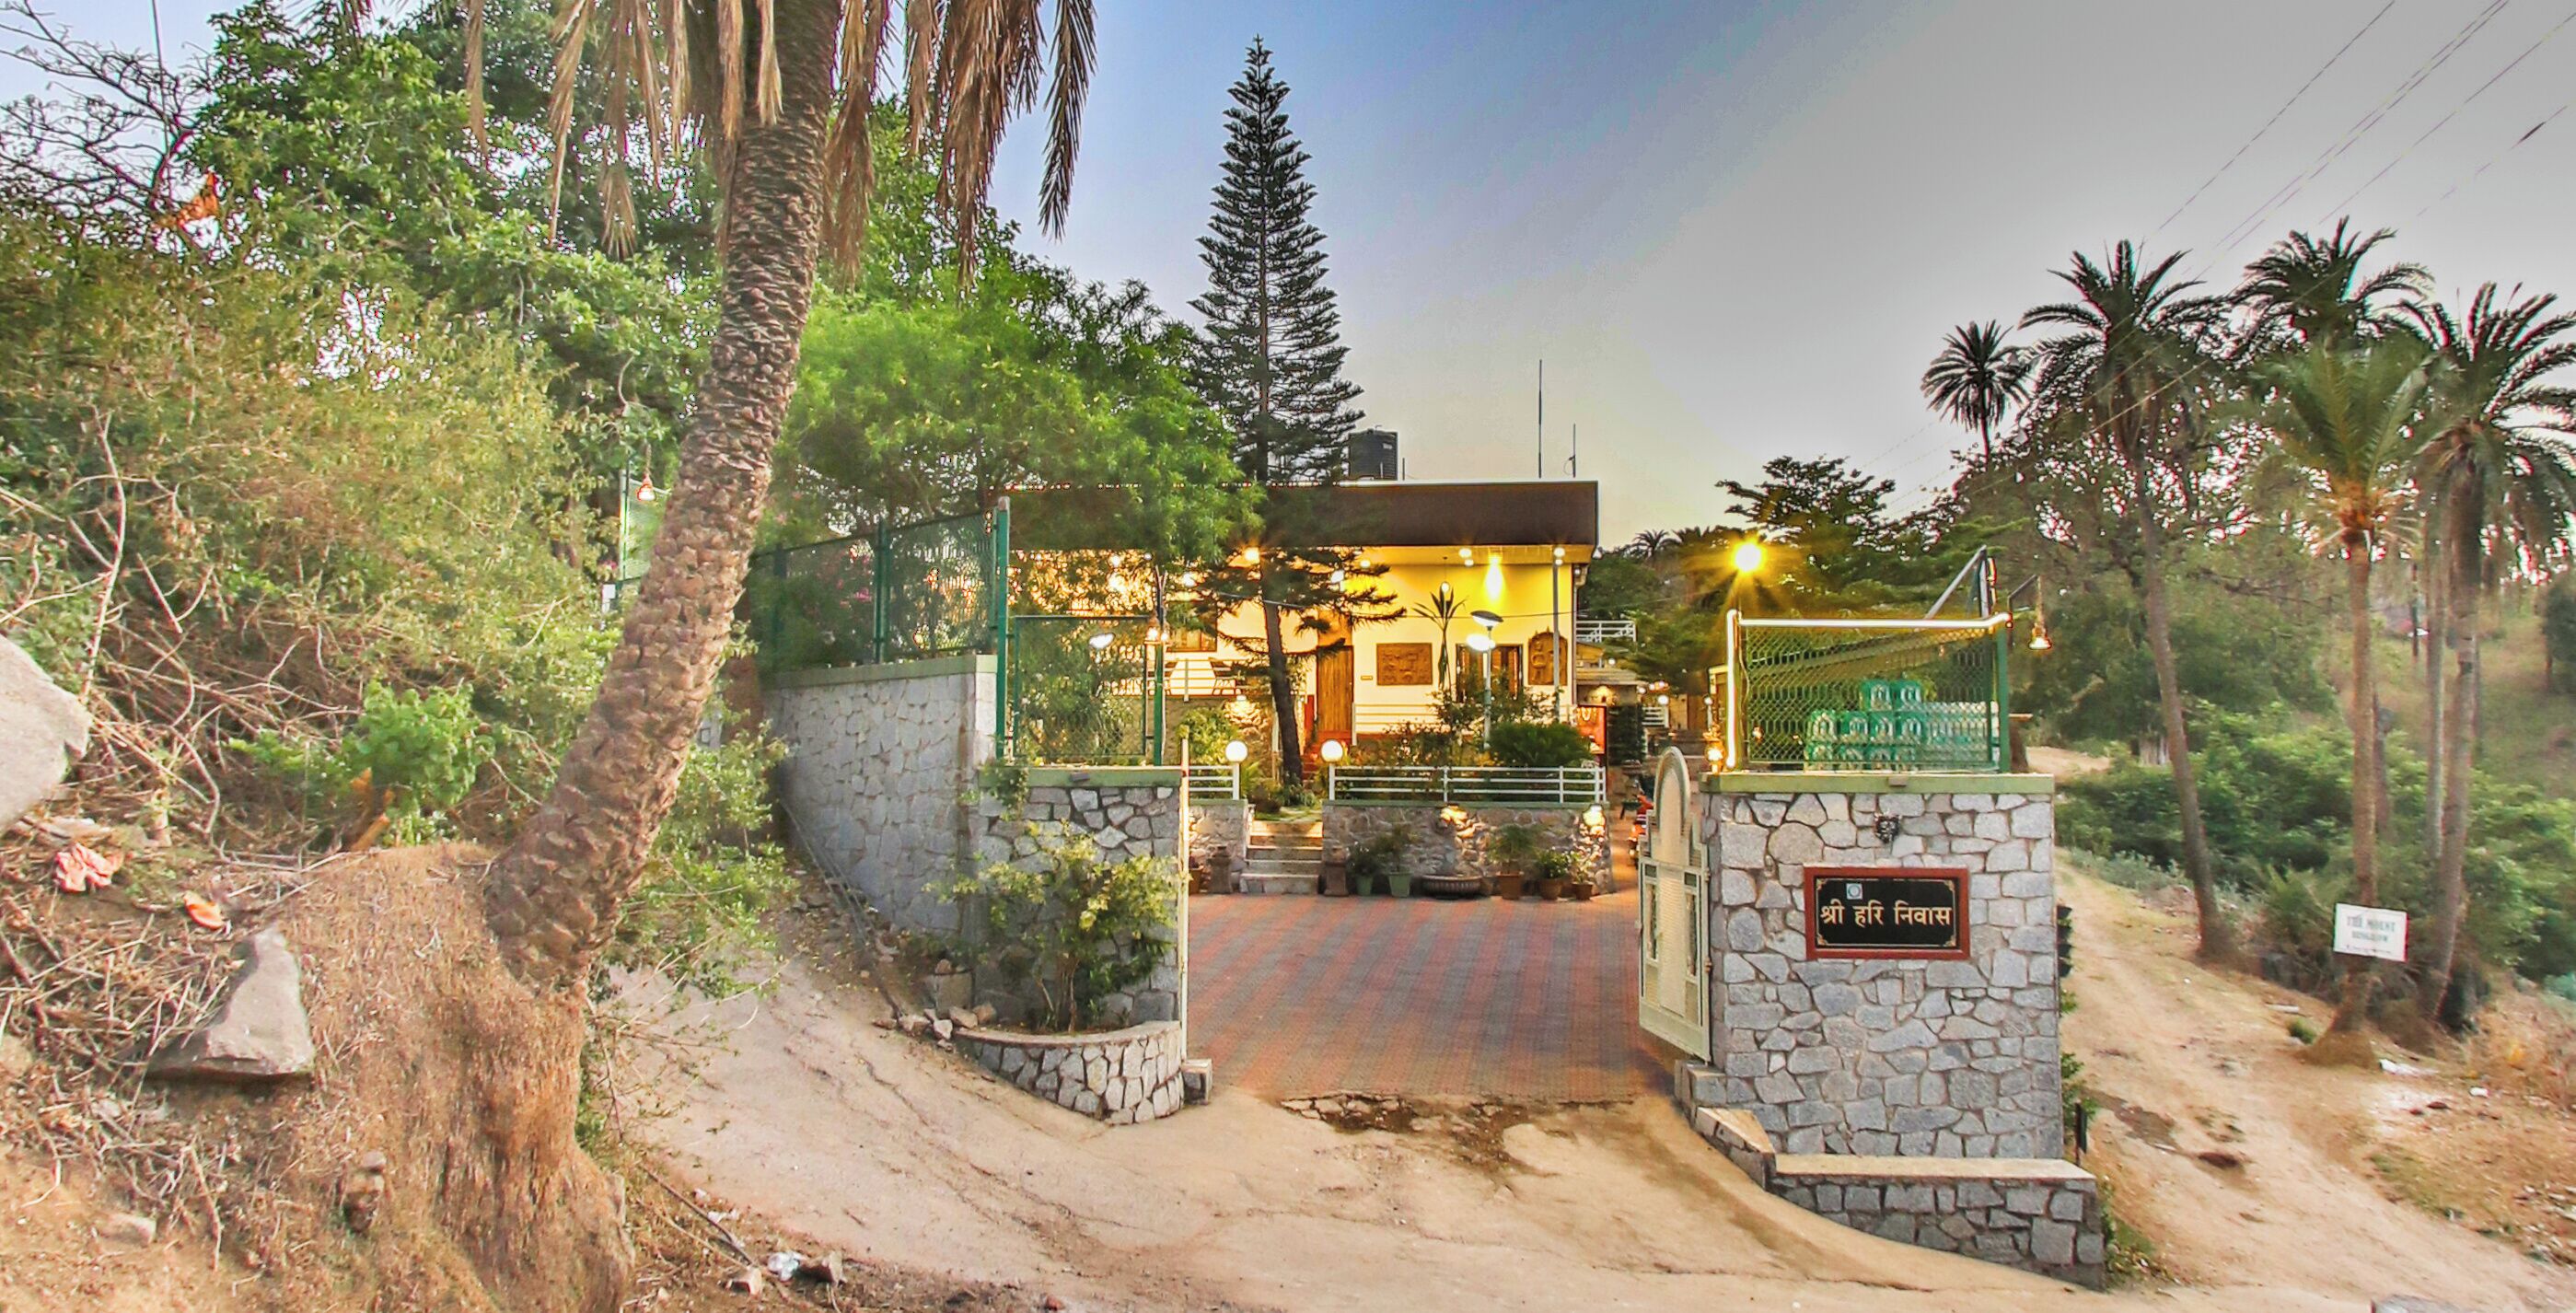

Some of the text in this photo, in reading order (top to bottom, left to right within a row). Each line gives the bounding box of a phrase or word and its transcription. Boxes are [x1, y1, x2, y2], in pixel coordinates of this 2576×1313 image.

[1820, 899, 1953, 927] श्री हरि निवास
